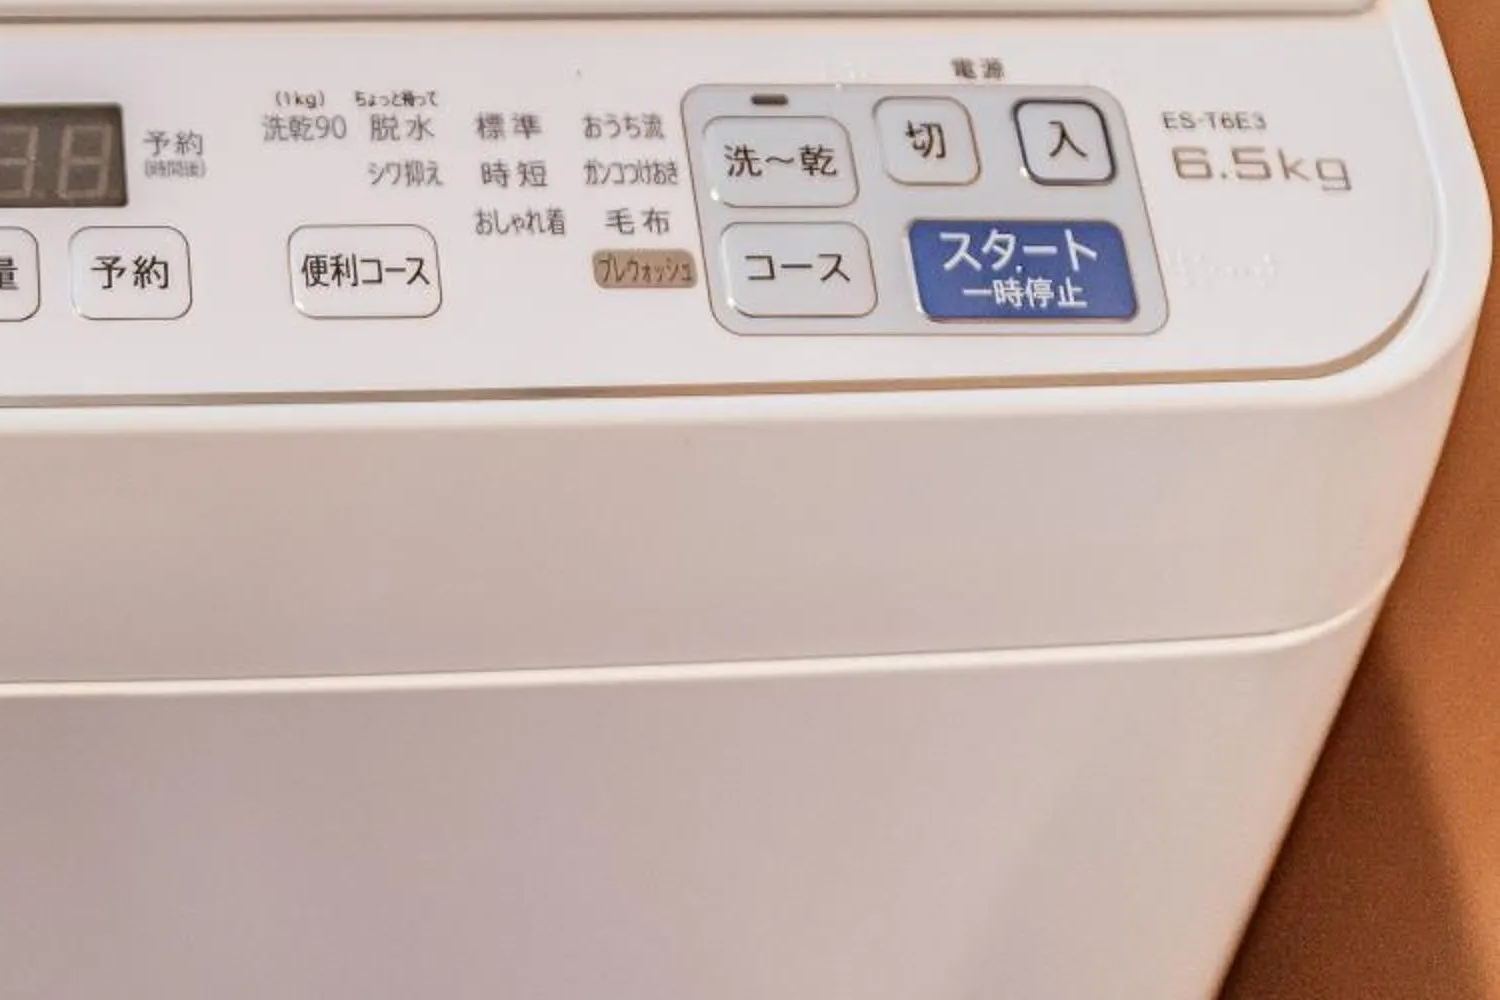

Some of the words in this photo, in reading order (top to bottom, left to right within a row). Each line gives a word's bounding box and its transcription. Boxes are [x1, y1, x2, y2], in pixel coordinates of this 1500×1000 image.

[951, 57, 1005, 81] 電源
[275, 90, 325, 110] (1kg)
[261, 113, 348, 142] 洗乾90
[369, 113, 435, 142] 脱水
[475, 112, 542, 141] 標準
[582, 112, 665, 141] おうち流
[1161, 111, 1267, 131] ES-T6E3
[142, 129, 204, 158] 予約
[904, 119, 947, 160] 切
[1048, 120, 1088, 159] 入
[367, 159, 444, 188] シワ抑え
[479, 159, 549, 189] 時短
[583, 159, 679, 186] ガンコつけおき
[1171, 145, 1353, 192] 6.5kg
[474, 207, 566, 237] おしゃれ着
[604, 207, 670, 236] 毛布
[939, 228, 1098, 273] スタート
[90, 255, 169, 291] 予約
[300, 252, 431, 289] 便利コース
[744, 253, 851, 283] コース
[962, 276, 1088, 309] 一時停止
